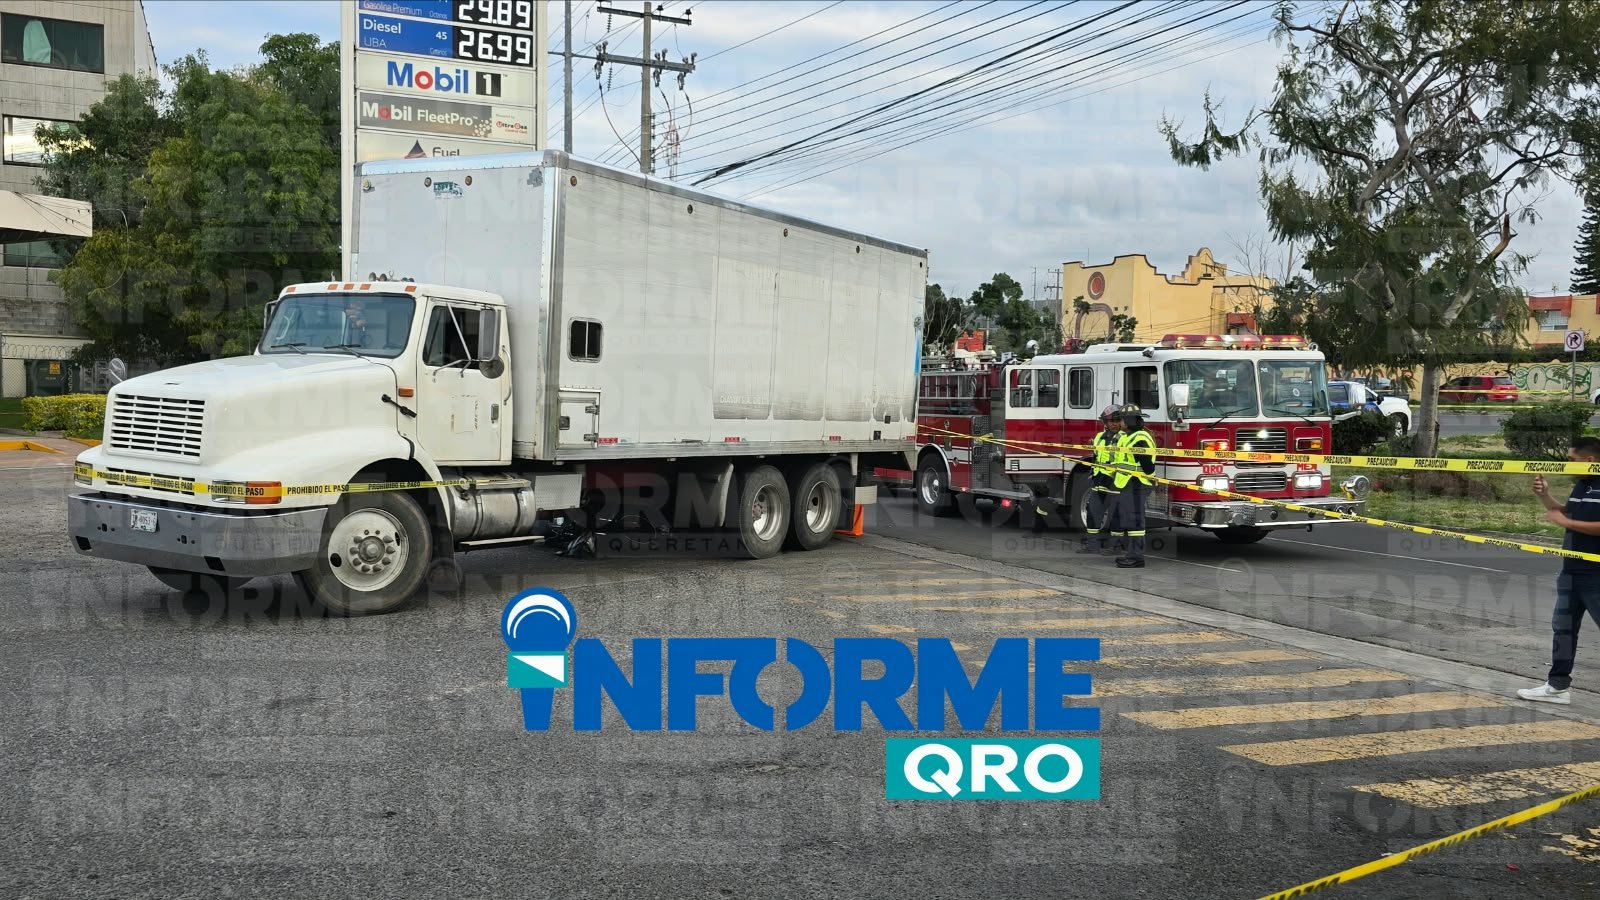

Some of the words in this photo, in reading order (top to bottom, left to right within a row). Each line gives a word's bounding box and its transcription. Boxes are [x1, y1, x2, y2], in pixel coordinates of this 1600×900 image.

[364, 0, 392, 12] Gasolina
[392, 3, 422, 16] Premium
[459, 0, 530, 28] 29.89
[364, 18, 402, 34] Diesel
[436, 32, 448, 40] 45
[364, 36, 387, 48] UBA
[459, 30, 530, 64] 26.99
[387, 60, 469, 94] Mobil
[362, 102, 412, 122] Mobil
[1284, 454, 1310, 462] PRECAUCION
[1324, 456, 1352, 464] PRECAUCION
[1366, 457, 1398, 466] PRECAUCION
[1414, 458, 1448, 468] PRECAUCION
[1466, 460, 1504, 470] PRECAUCION
[1524, 462, 1566, 472] PRECAUCION
[120, 474, 126, 482] EL
[150, 478, 174, 488] PROHIBIDO
[181, 482, 193, 490] PASO
[208, 484, 237, 494] PROHIBIDO
[246, 487, 264, 496] PASO
[287, 485, 323, 494] PROHIBIDO
[324, 484, 332, 493] EL
[333, 484, 350, 492] PASO
